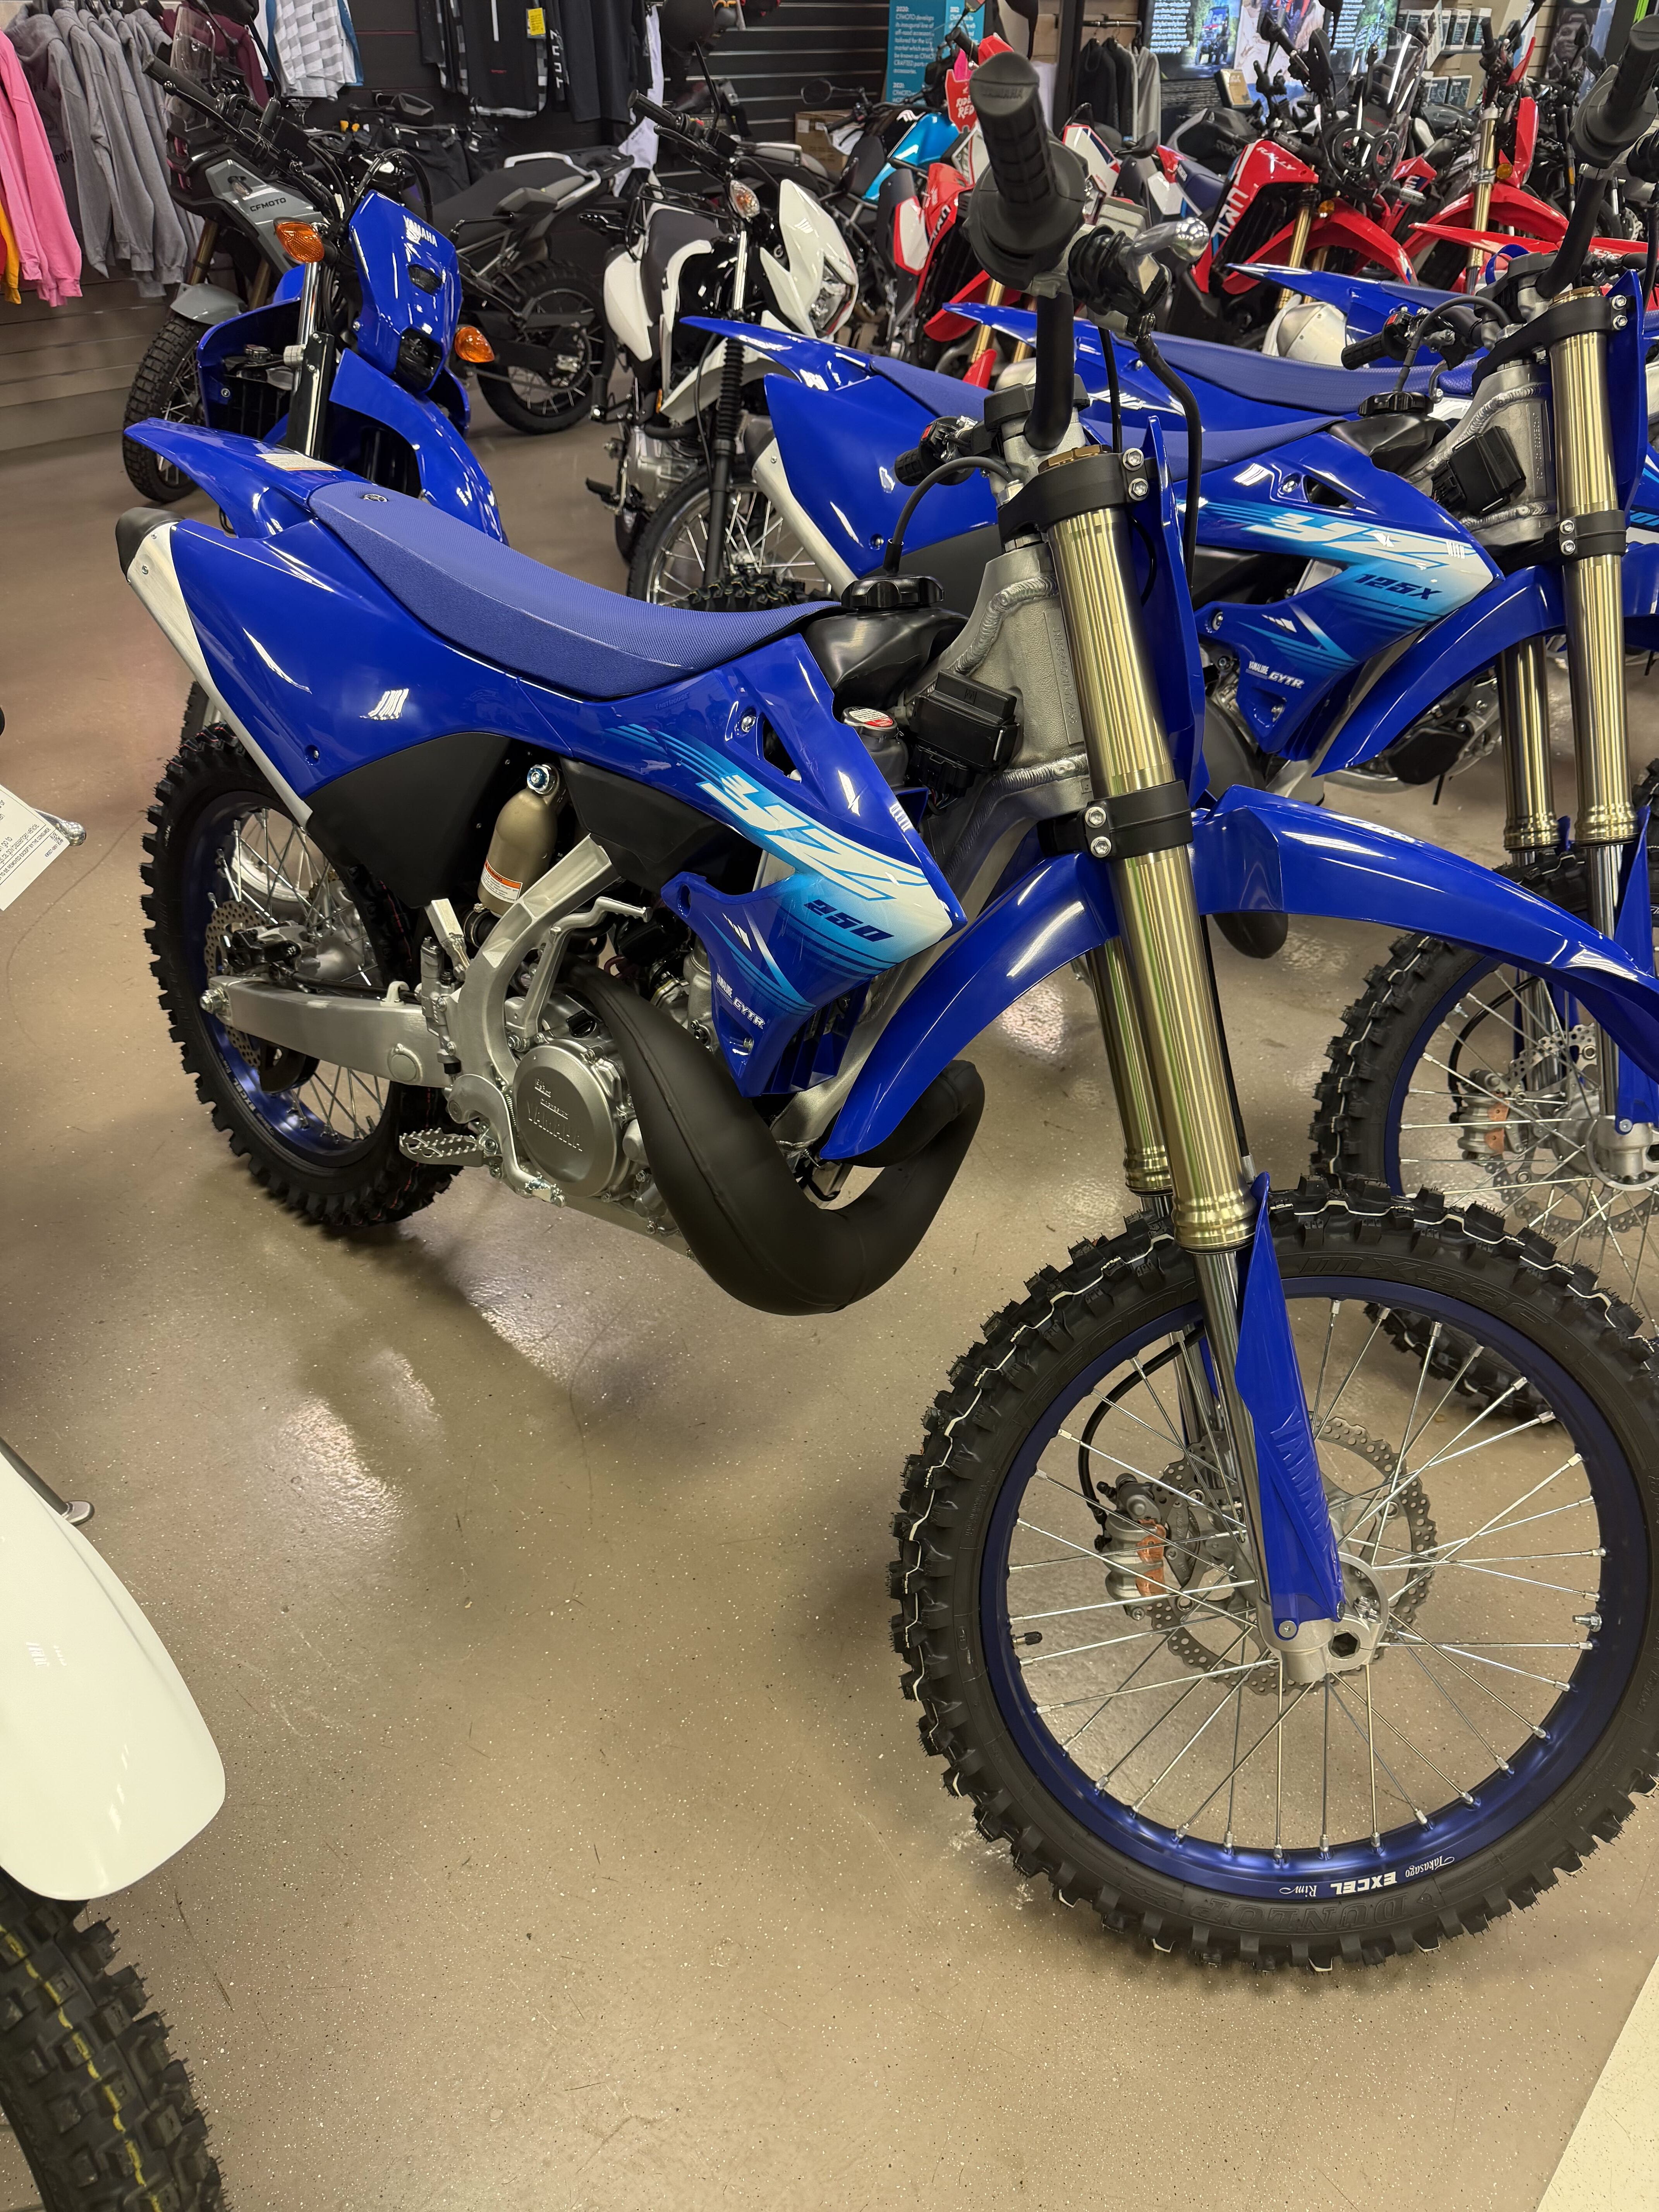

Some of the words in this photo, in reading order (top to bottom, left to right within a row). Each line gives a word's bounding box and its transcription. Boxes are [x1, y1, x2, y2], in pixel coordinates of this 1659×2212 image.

[250, 197, 287, 212] CFMOTO
[1211, 187, 1249, 237] CRF
[402, 215, 438, 247] YAMAHA
[1354, 573, 1443, 600] 125X
[1268, 671, 1305, 689] GYTR
[804, 899, 895, 942] 250
[733, 997, 766, 1029] GYTR
[1405, 1855, 1455, 1878] Takasago
[1279, 1884, 1317, 1897] Rim
[1330, 1871, 1398, 1896] EXCEL
[1188, 1891, 1409, 1933] DUNLOP
